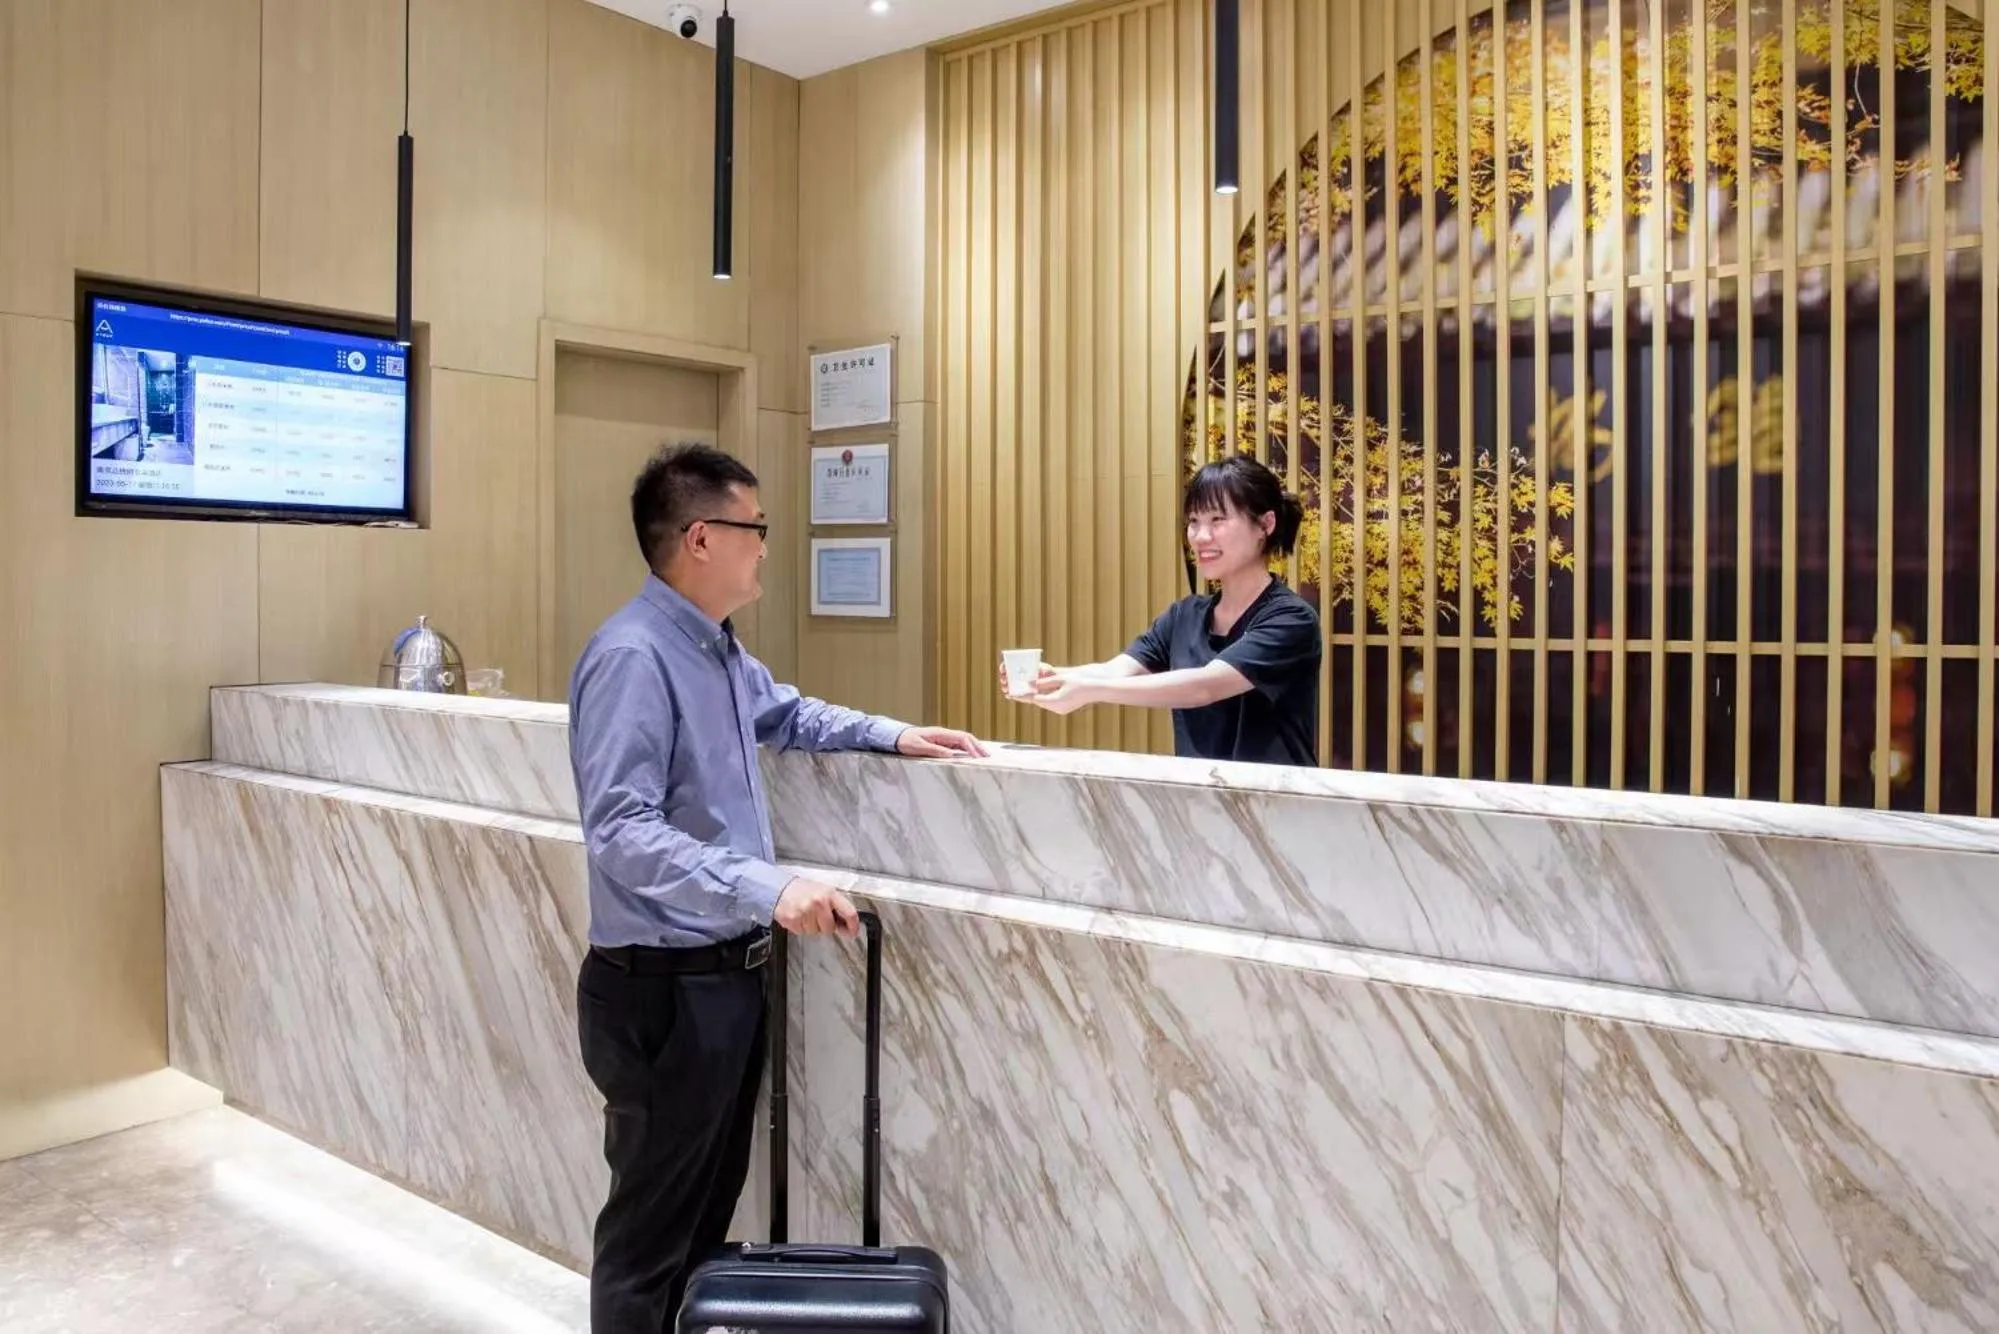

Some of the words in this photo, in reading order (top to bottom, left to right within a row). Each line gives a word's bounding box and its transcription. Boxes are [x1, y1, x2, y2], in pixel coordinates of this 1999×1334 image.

[833, 357, 874, 372] 卫生许可证
